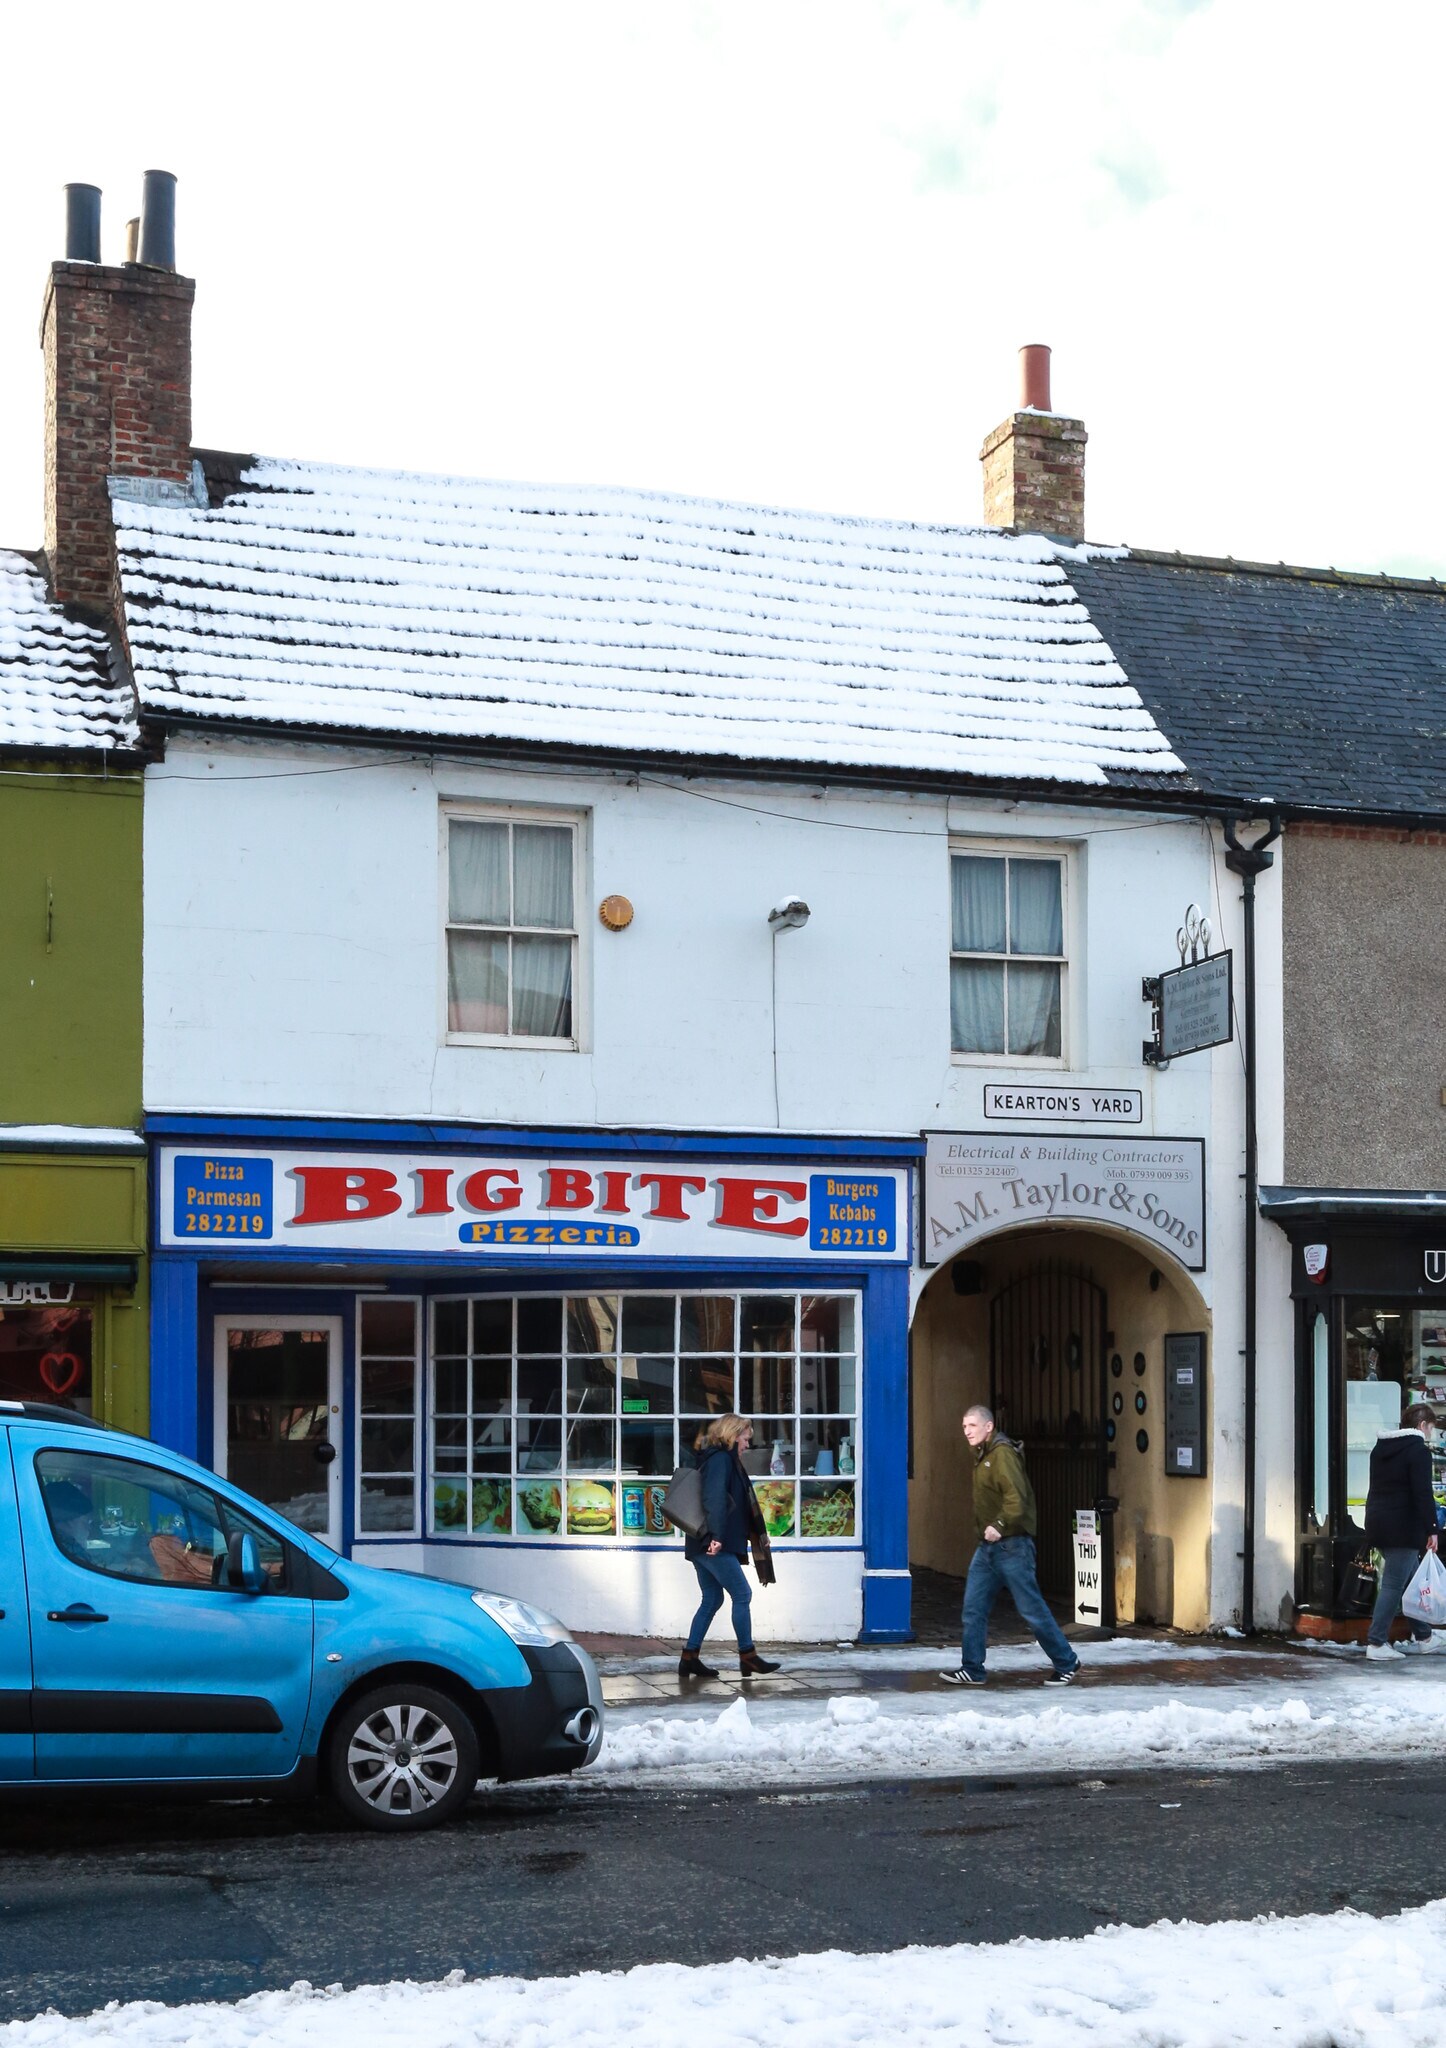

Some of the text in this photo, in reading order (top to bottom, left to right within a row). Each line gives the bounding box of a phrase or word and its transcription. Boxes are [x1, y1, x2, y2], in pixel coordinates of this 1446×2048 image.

[994, 1095, 1133, 1113] KEARTON'S YARD
[947, 1145, 1184, 1166] Electrical & Building Contractors
[204, 1161, 245, 1181] Pizza
[939, 1166, 1016, 1177] Tel: 01325 242407
[1106, 1170, 1189, 1180] Mob. 07939 009 395
[186, 1187, 262, 1207] Parmesan
[826, 1179, 879, 1201] Burgers
[289, 1166, 809, 1238] BIG BITE
[930, 1190, 1000, 1248] A.M.
[1001, 1171, 1107, 1214] Taylor
[185, 1213, 264, 1233] 282219
[829, 1204, 876, 1222] Kebabs
[471, 1222, 633, 1245] Pizzeria
[819, 1228, 888, 1246] 282219
[1078, 1543, 1097, 1559] THIS
[1077, 1571, 1099, 1589] WAY
